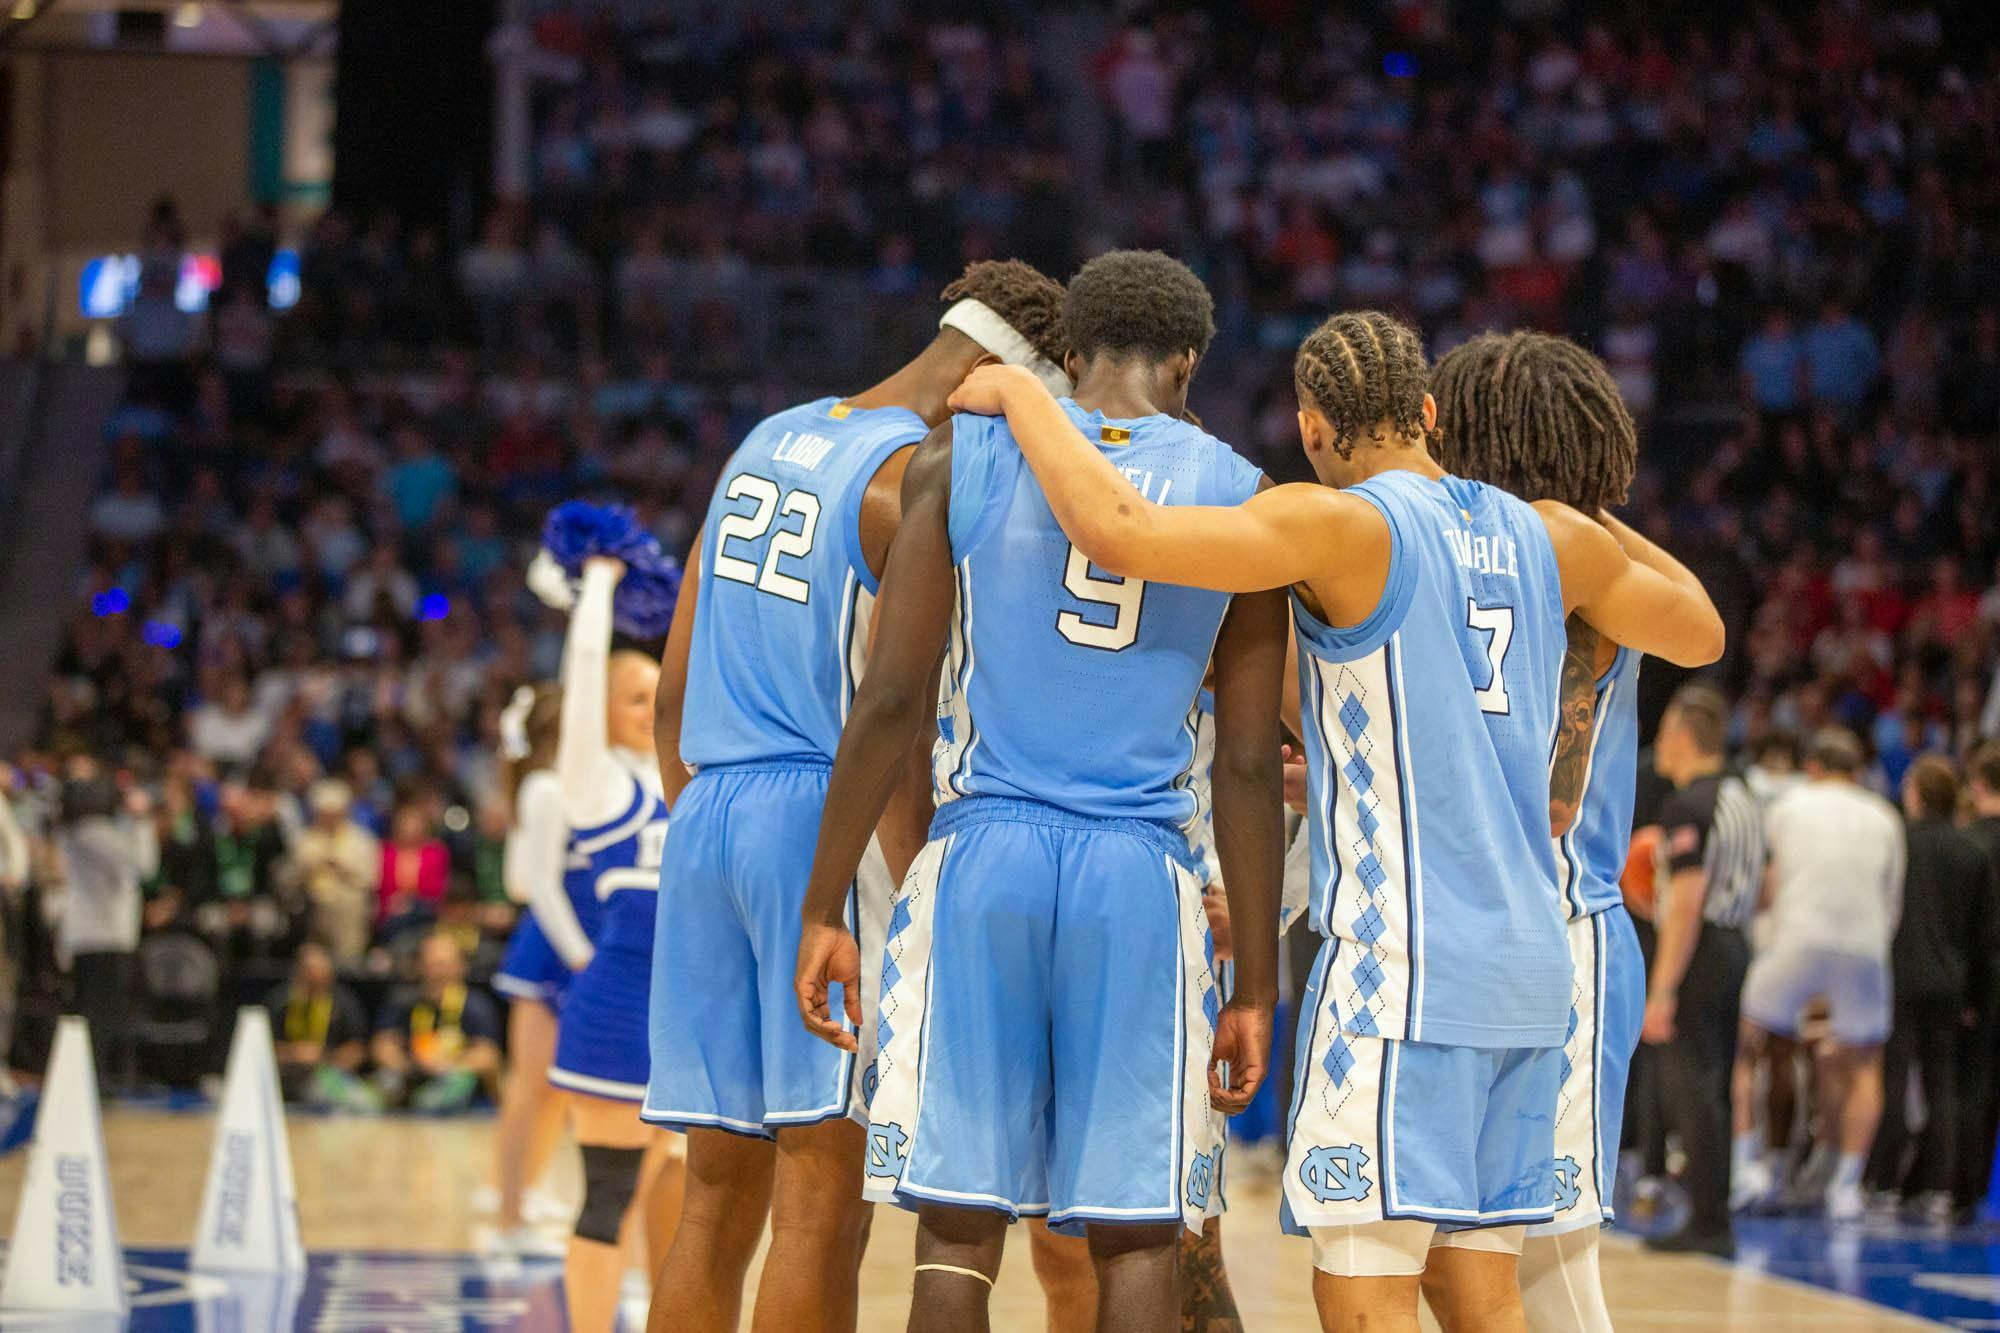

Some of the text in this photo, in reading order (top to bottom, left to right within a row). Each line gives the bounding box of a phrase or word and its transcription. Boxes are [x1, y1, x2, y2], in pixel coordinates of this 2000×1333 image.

[714, 472, 821, 605] 22
[1055, 541, 1146, 652] 9
[1467, 596, 1515, 716] 7
